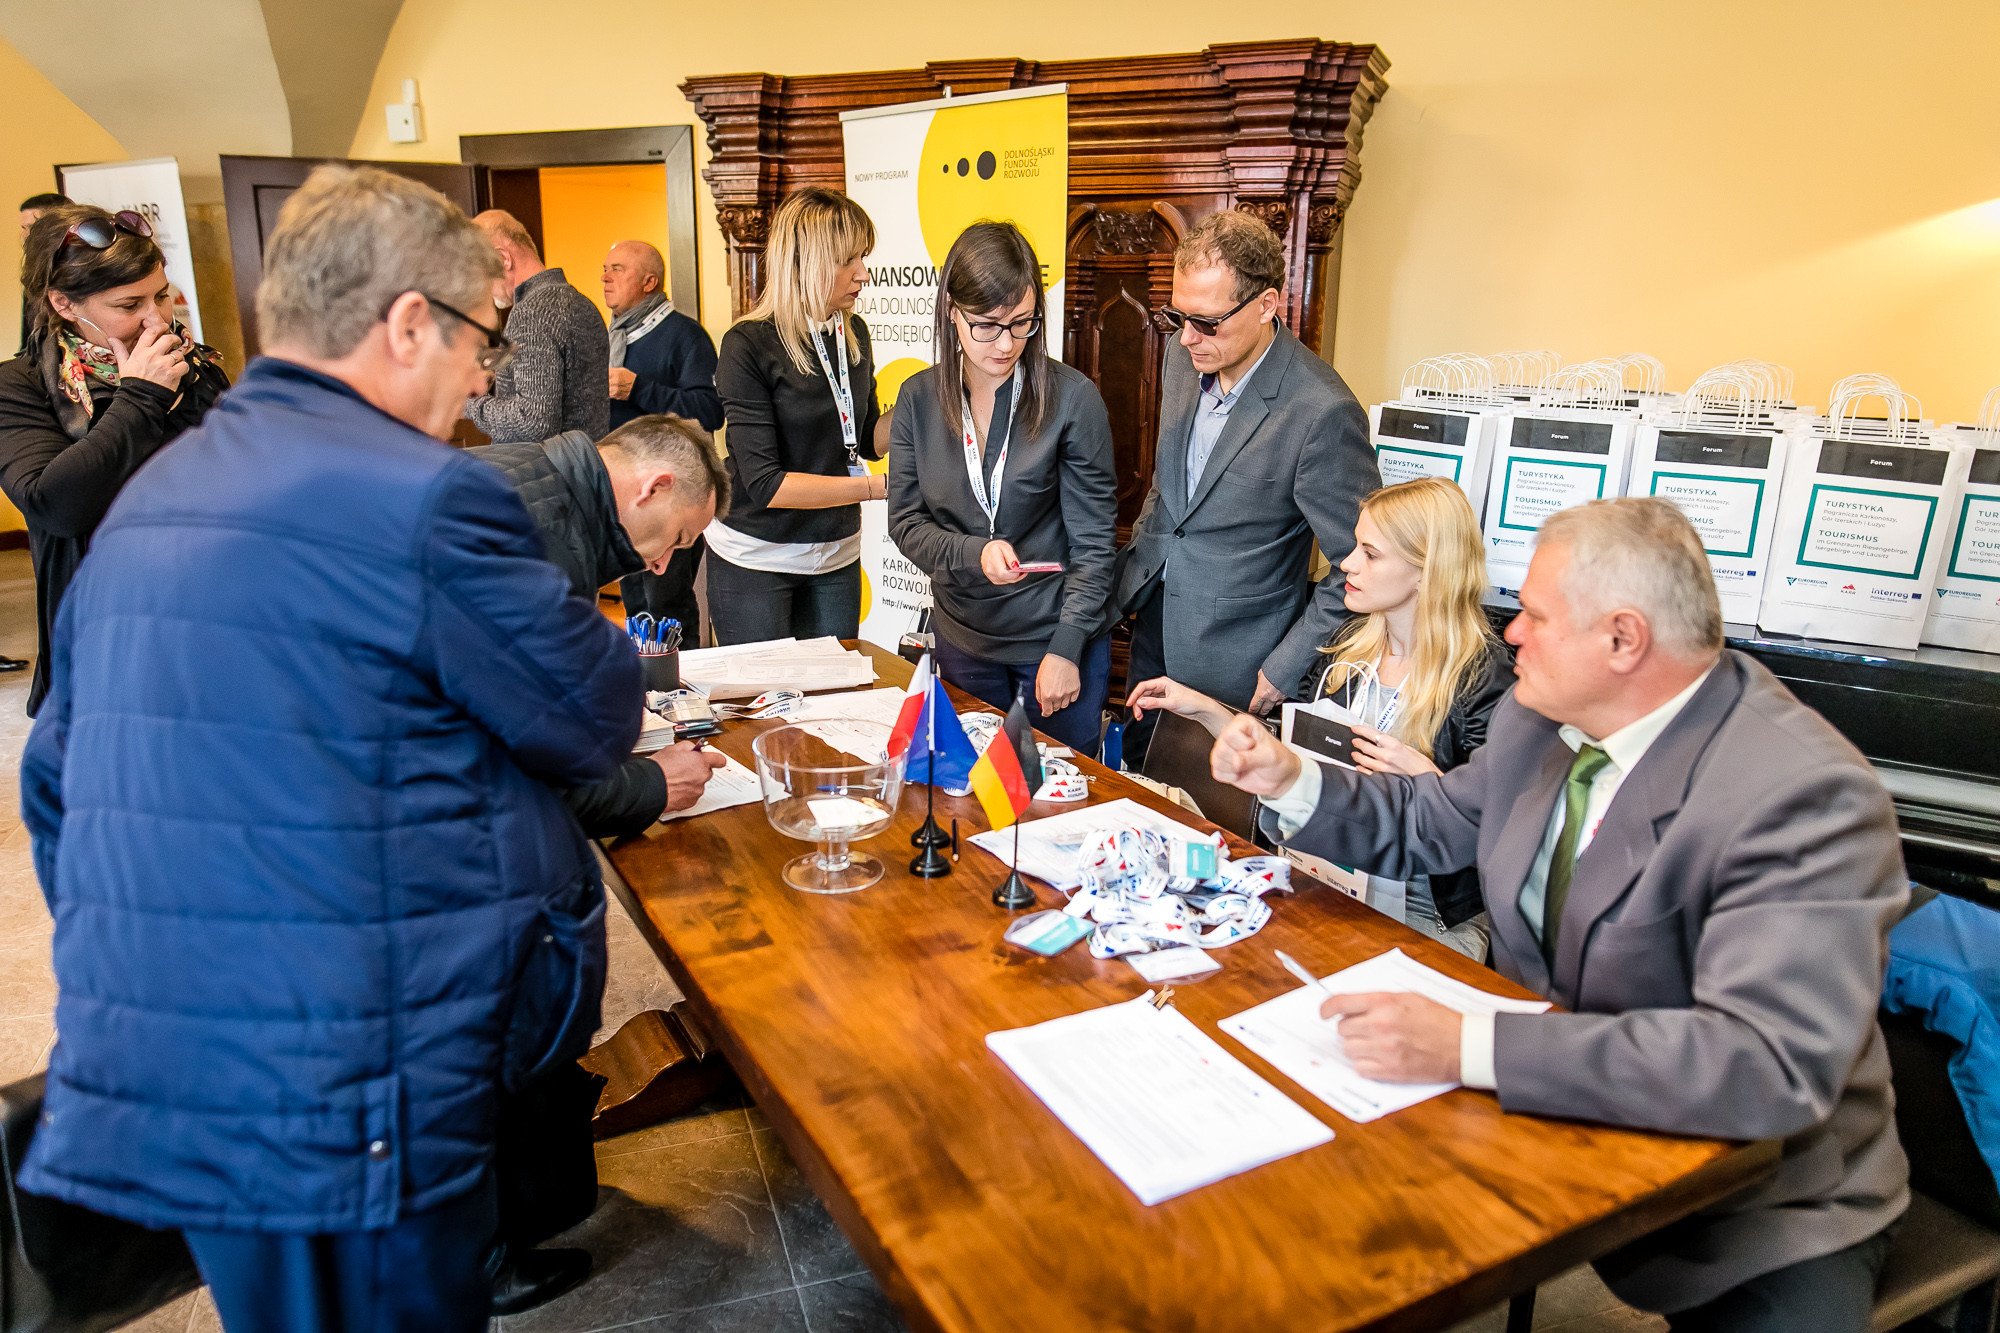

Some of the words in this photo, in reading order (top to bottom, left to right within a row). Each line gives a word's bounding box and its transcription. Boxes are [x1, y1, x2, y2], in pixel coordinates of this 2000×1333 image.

[1004, 146, 1055, 159] DOLNOŚLĄSKI
[1004, 158, 1038, 168] FUNDUSZ
[854, 173, 875, 182] NOWY
[875, 170, 909, 181] PROGRAM
[1003, 169, 1040, 179] ROZWOJU
[856, 297, 877, 315] DLA
[1384, 458, 1425, 470] TURYSTYKA
[1870, 459, 1893, 467] Forum
[1518, 470, 1565, 480] TURYSTYKA
[1665, 486, 1717, 496] TURYSTYKA
[1515, 496, 1562, 506] TOURISMUS
[1826, 500, 1884, 513] TURYSTYKA
[1823, 509, 1858, 518] Pogranicza
[1819, 529, 1879, 543] TOURISMUS
[1325, 736, 1342, 747] Forum
